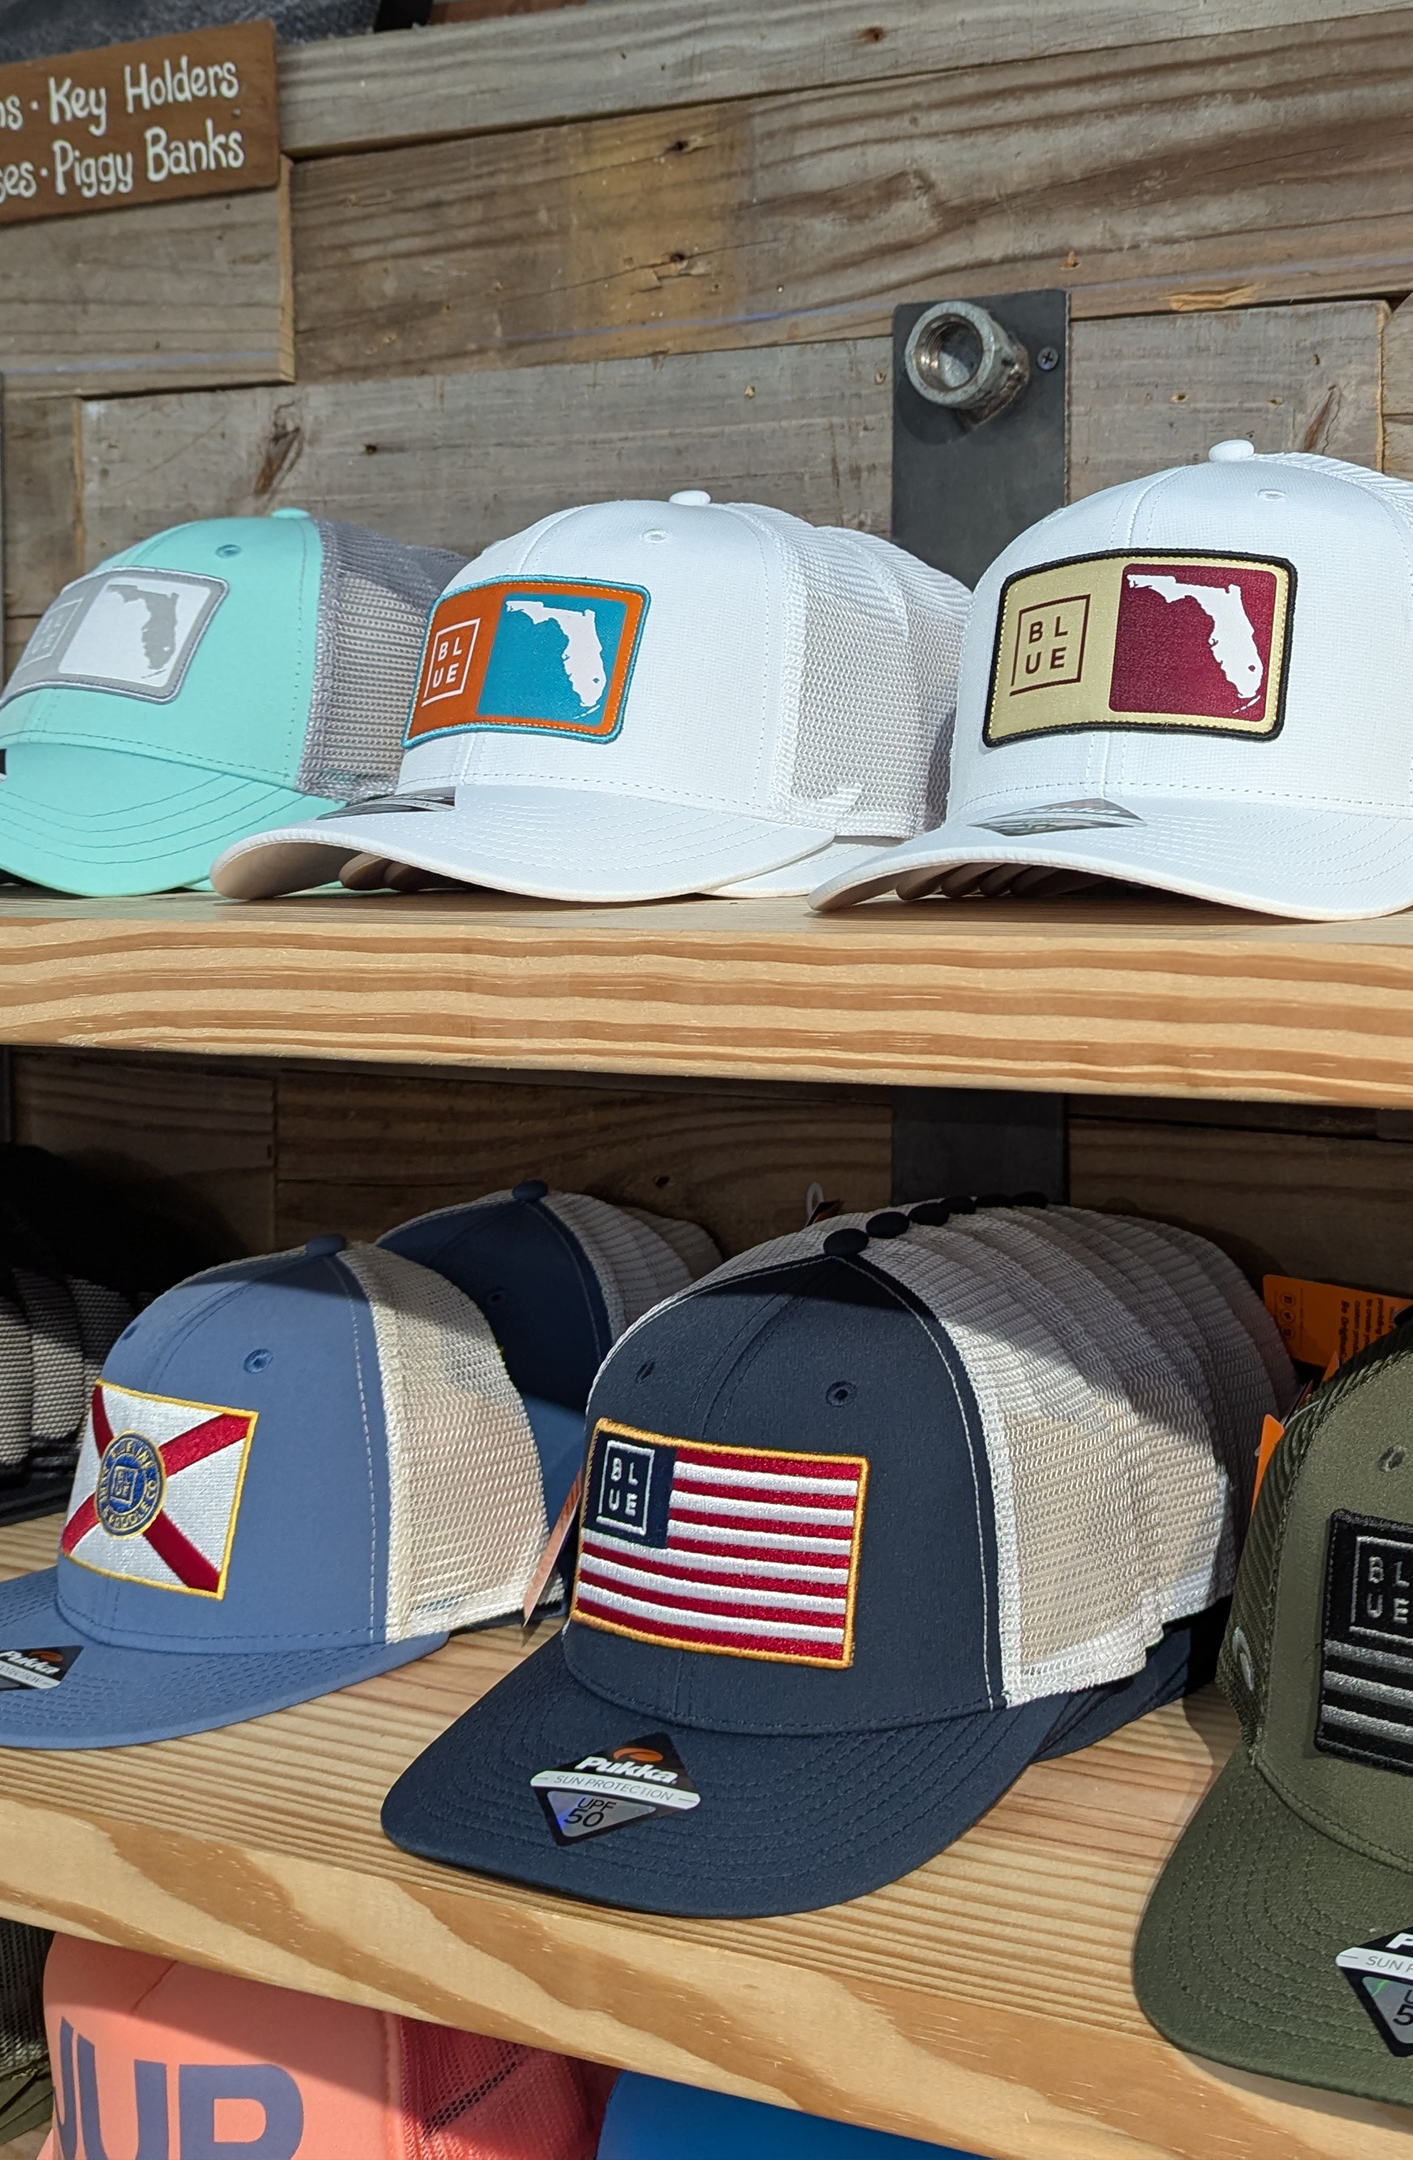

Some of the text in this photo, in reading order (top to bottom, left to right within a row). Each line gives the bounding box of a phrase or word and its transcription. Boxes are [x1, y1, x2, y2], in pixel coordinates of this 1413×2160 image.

[49, 76, 107, 137] Key
[124, 55, 240, 113] Holders
[52, 139, 133, 198] Piggy
[144, 118, 245, 183] Banks
[574, 1756, 678, 1783] Pukka
[554, 1775, 675, 1801] SUN PROTECTION
[577, 1797, 617, 1812] UPF
[564, 1808, 605, 1828] 50
[1366, 1956, 1404, 1971] SUN
